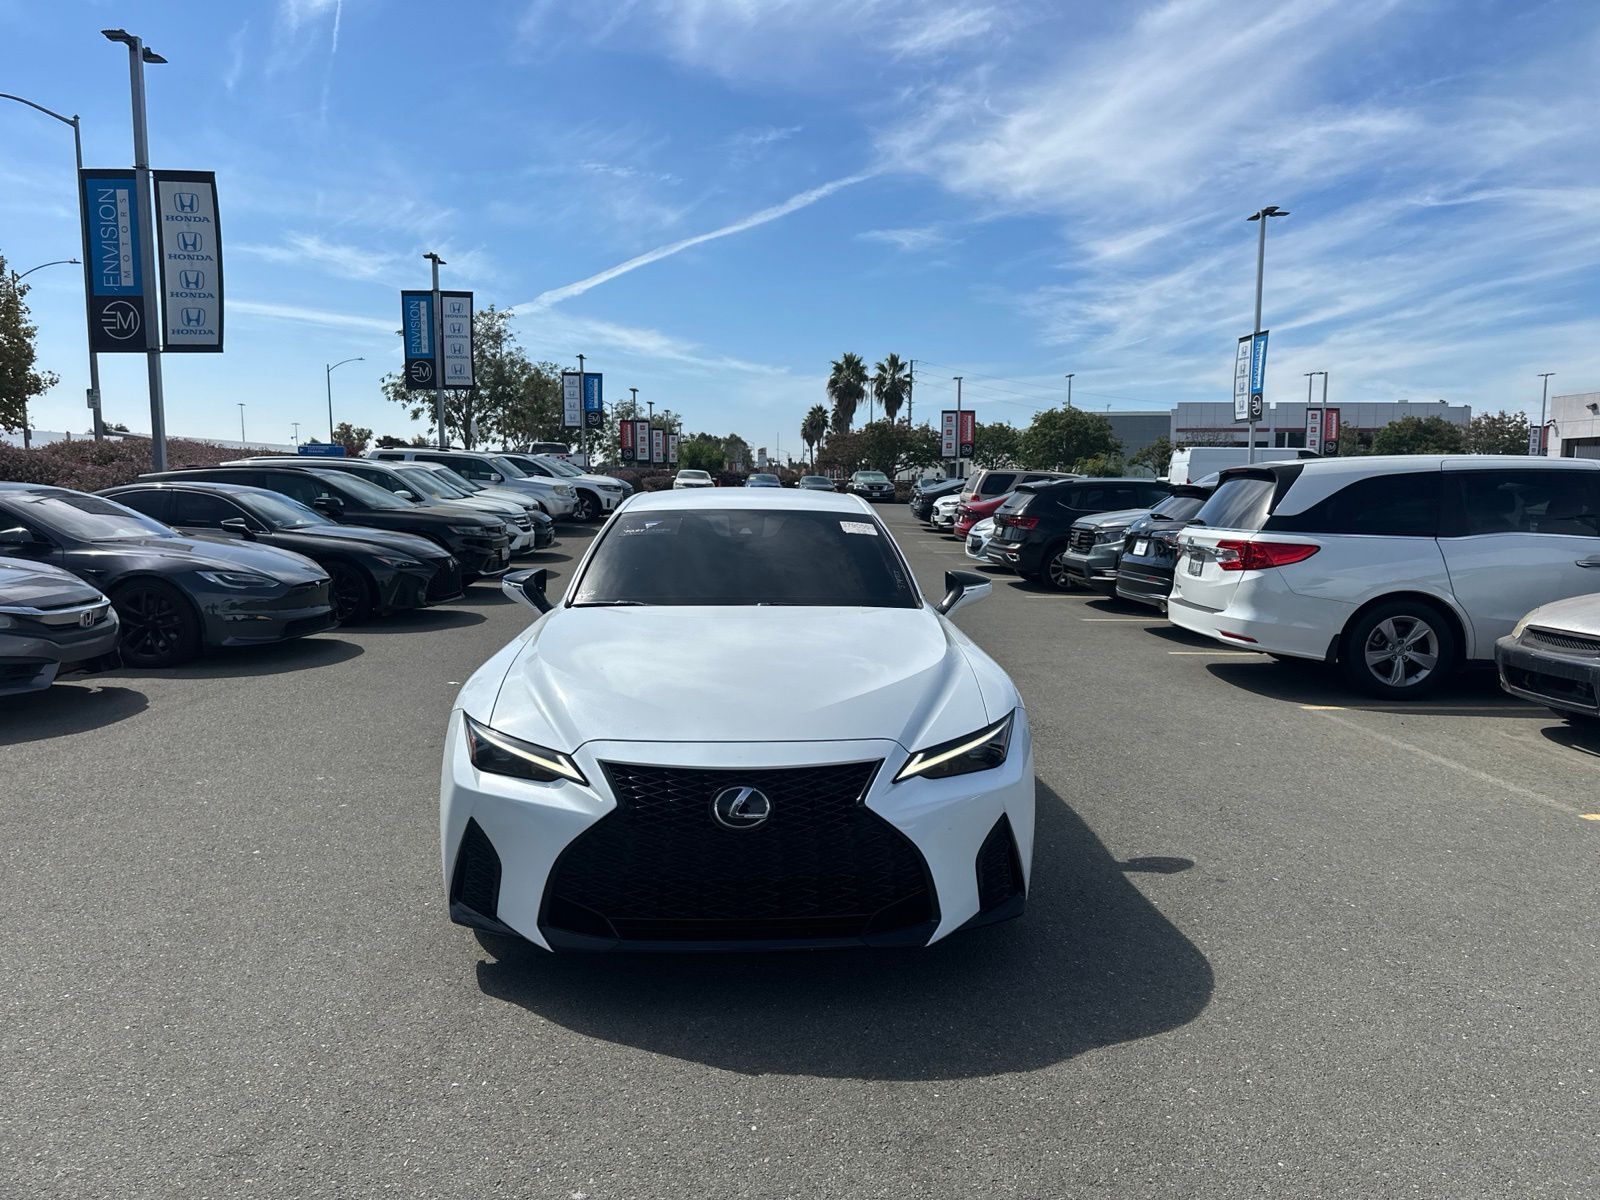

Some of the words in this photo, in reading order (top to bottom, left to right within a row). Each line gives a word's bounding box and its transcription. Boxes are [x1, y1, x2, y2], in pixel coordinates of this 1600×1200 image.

[165, 215, 211, 223] HONDA
[97, 188, 121, 288] ENVISION
[119, 197, 131, 279] MOTORS
[167, 253, 214, 262] HONDA
[170, 291, 215, 299] HONDA
[410, 300, 422, 354] ENVISION
